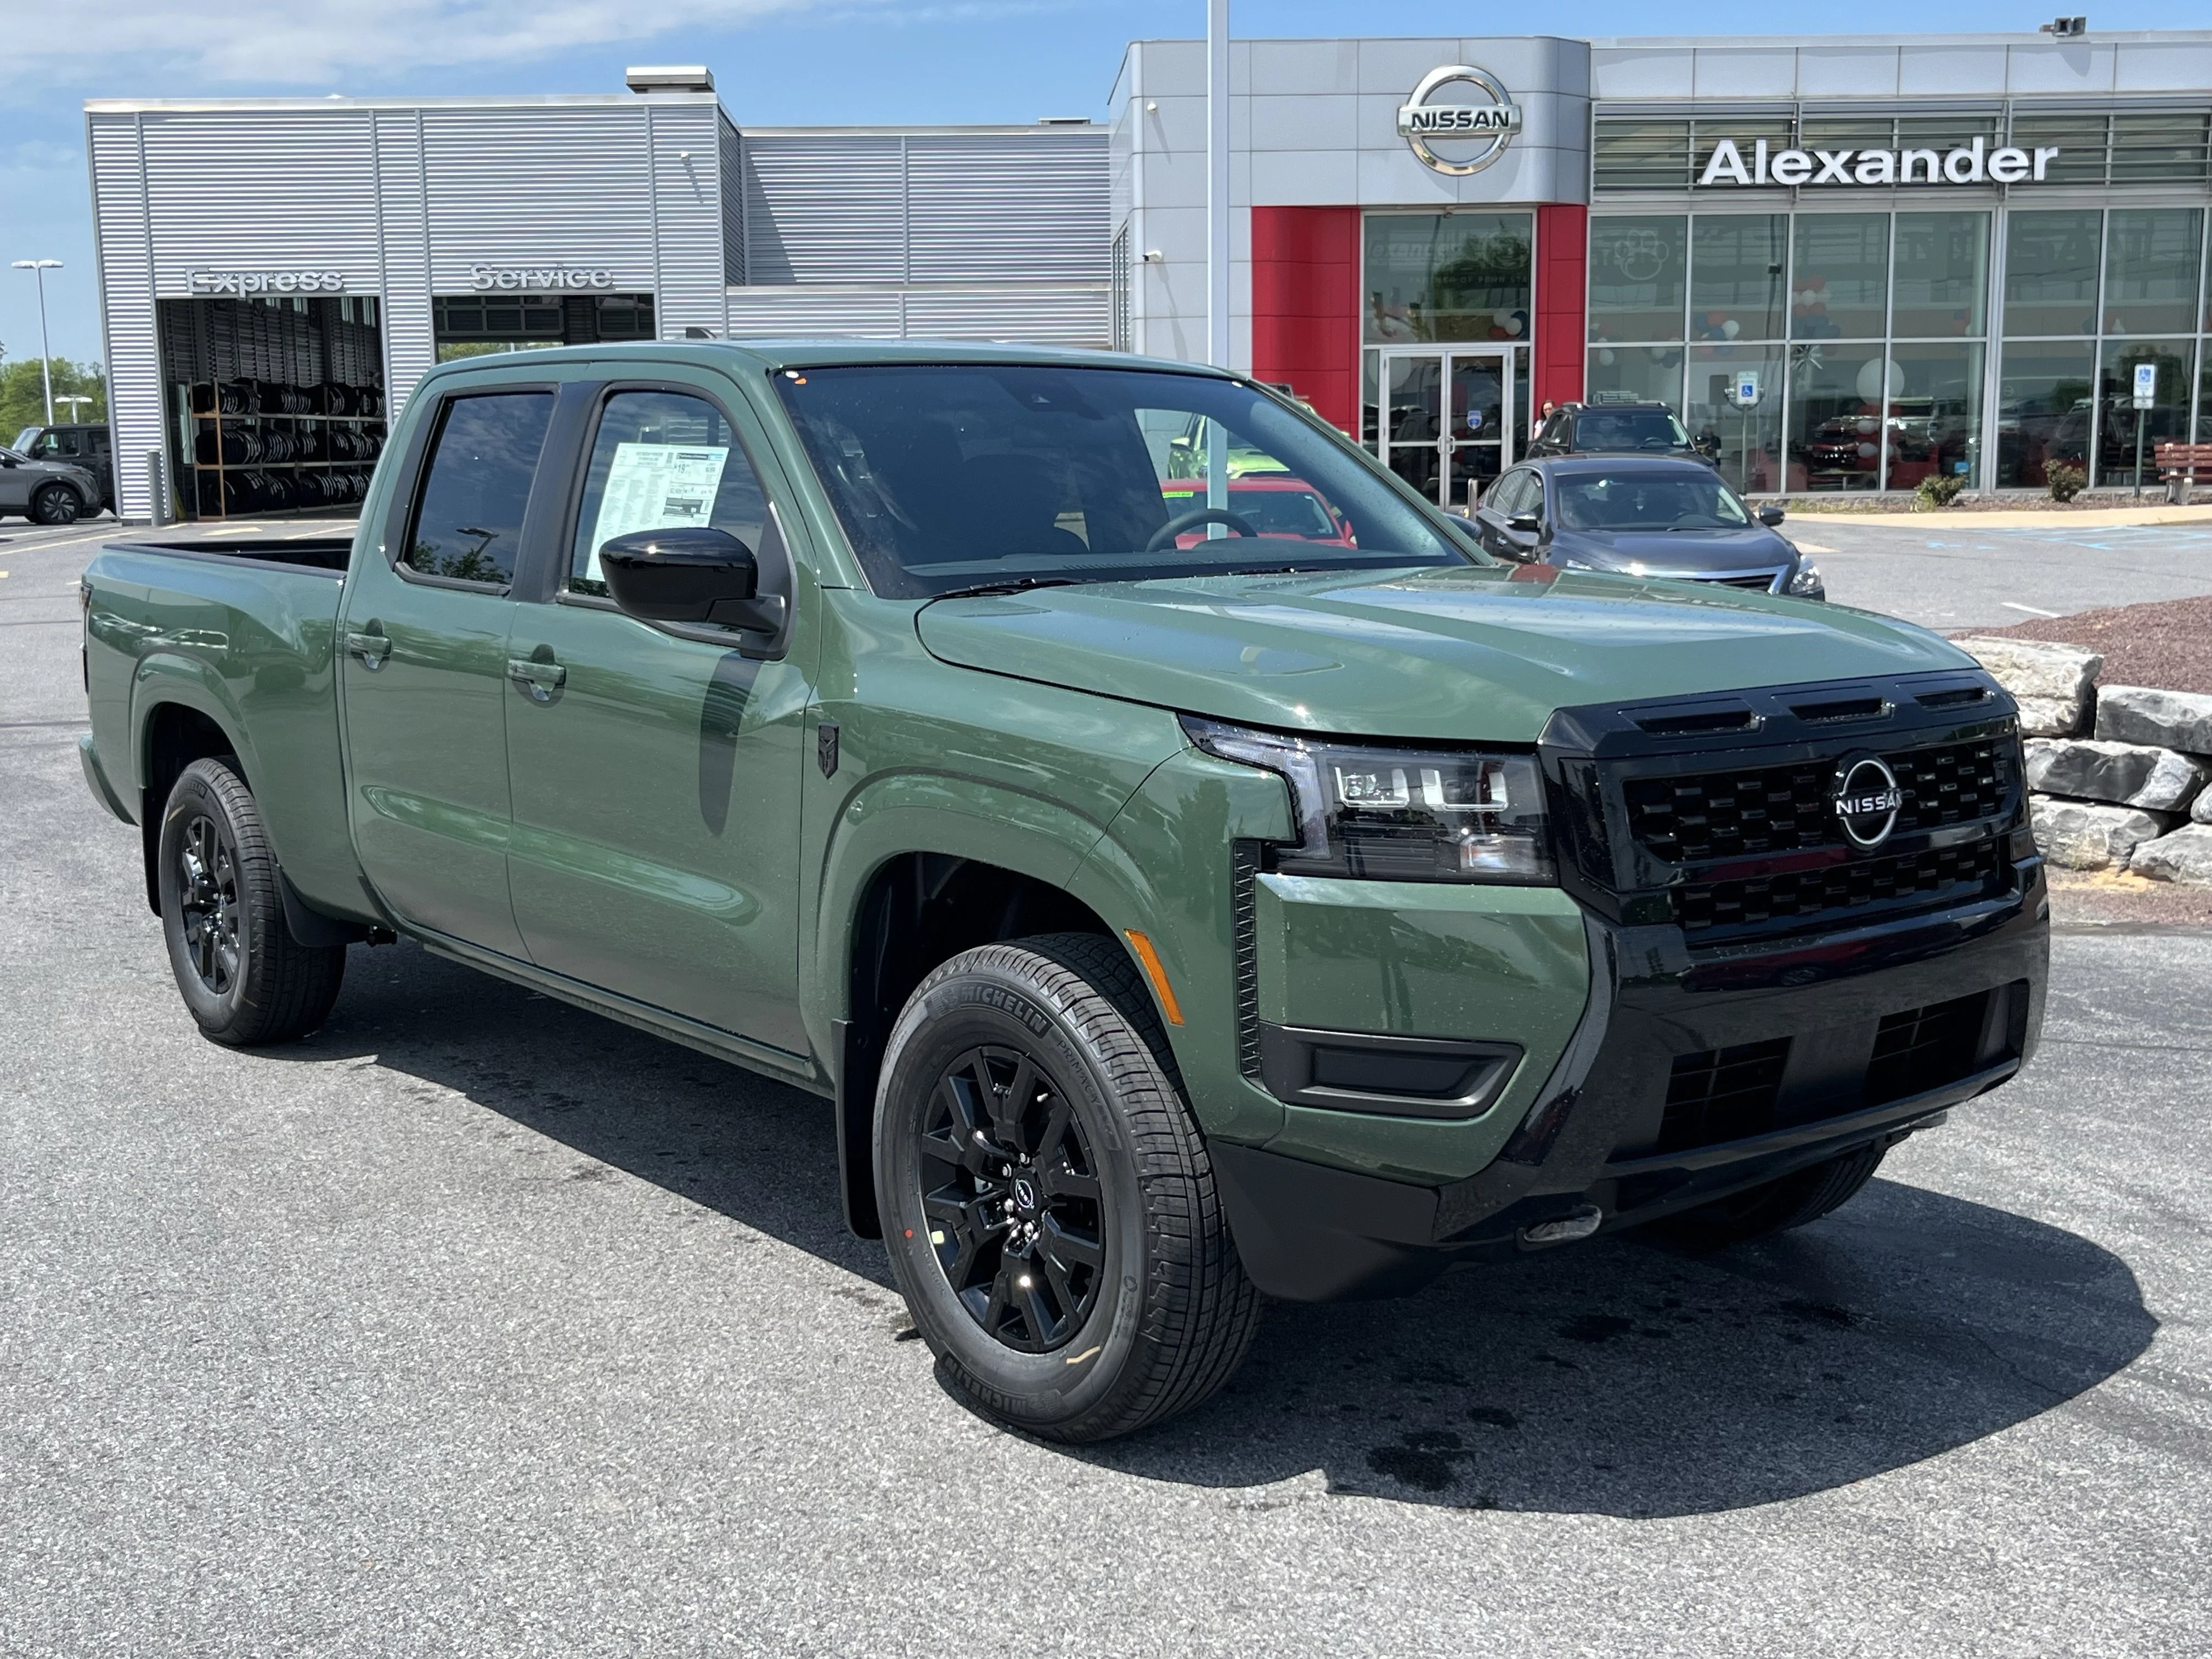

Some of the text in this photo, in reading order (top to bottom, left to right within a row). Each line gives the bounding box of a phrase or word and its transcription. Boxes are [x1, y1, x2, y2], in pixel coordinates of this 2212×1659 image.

[1410, 110, 1510, 131] NISSAN
[1700, 137, 2058, 185] Alexander
[186, 268, 345, 298] Express
[470, 263, 613, 289] Service
[1836, 793, 1901, 814] NISSAN
[961, 986, 1047, 1032] MICHELIN
[1057, 1040, 1102, 1106] PRIMACY
[945, 1358, 1026, 1415] MICHELIN
